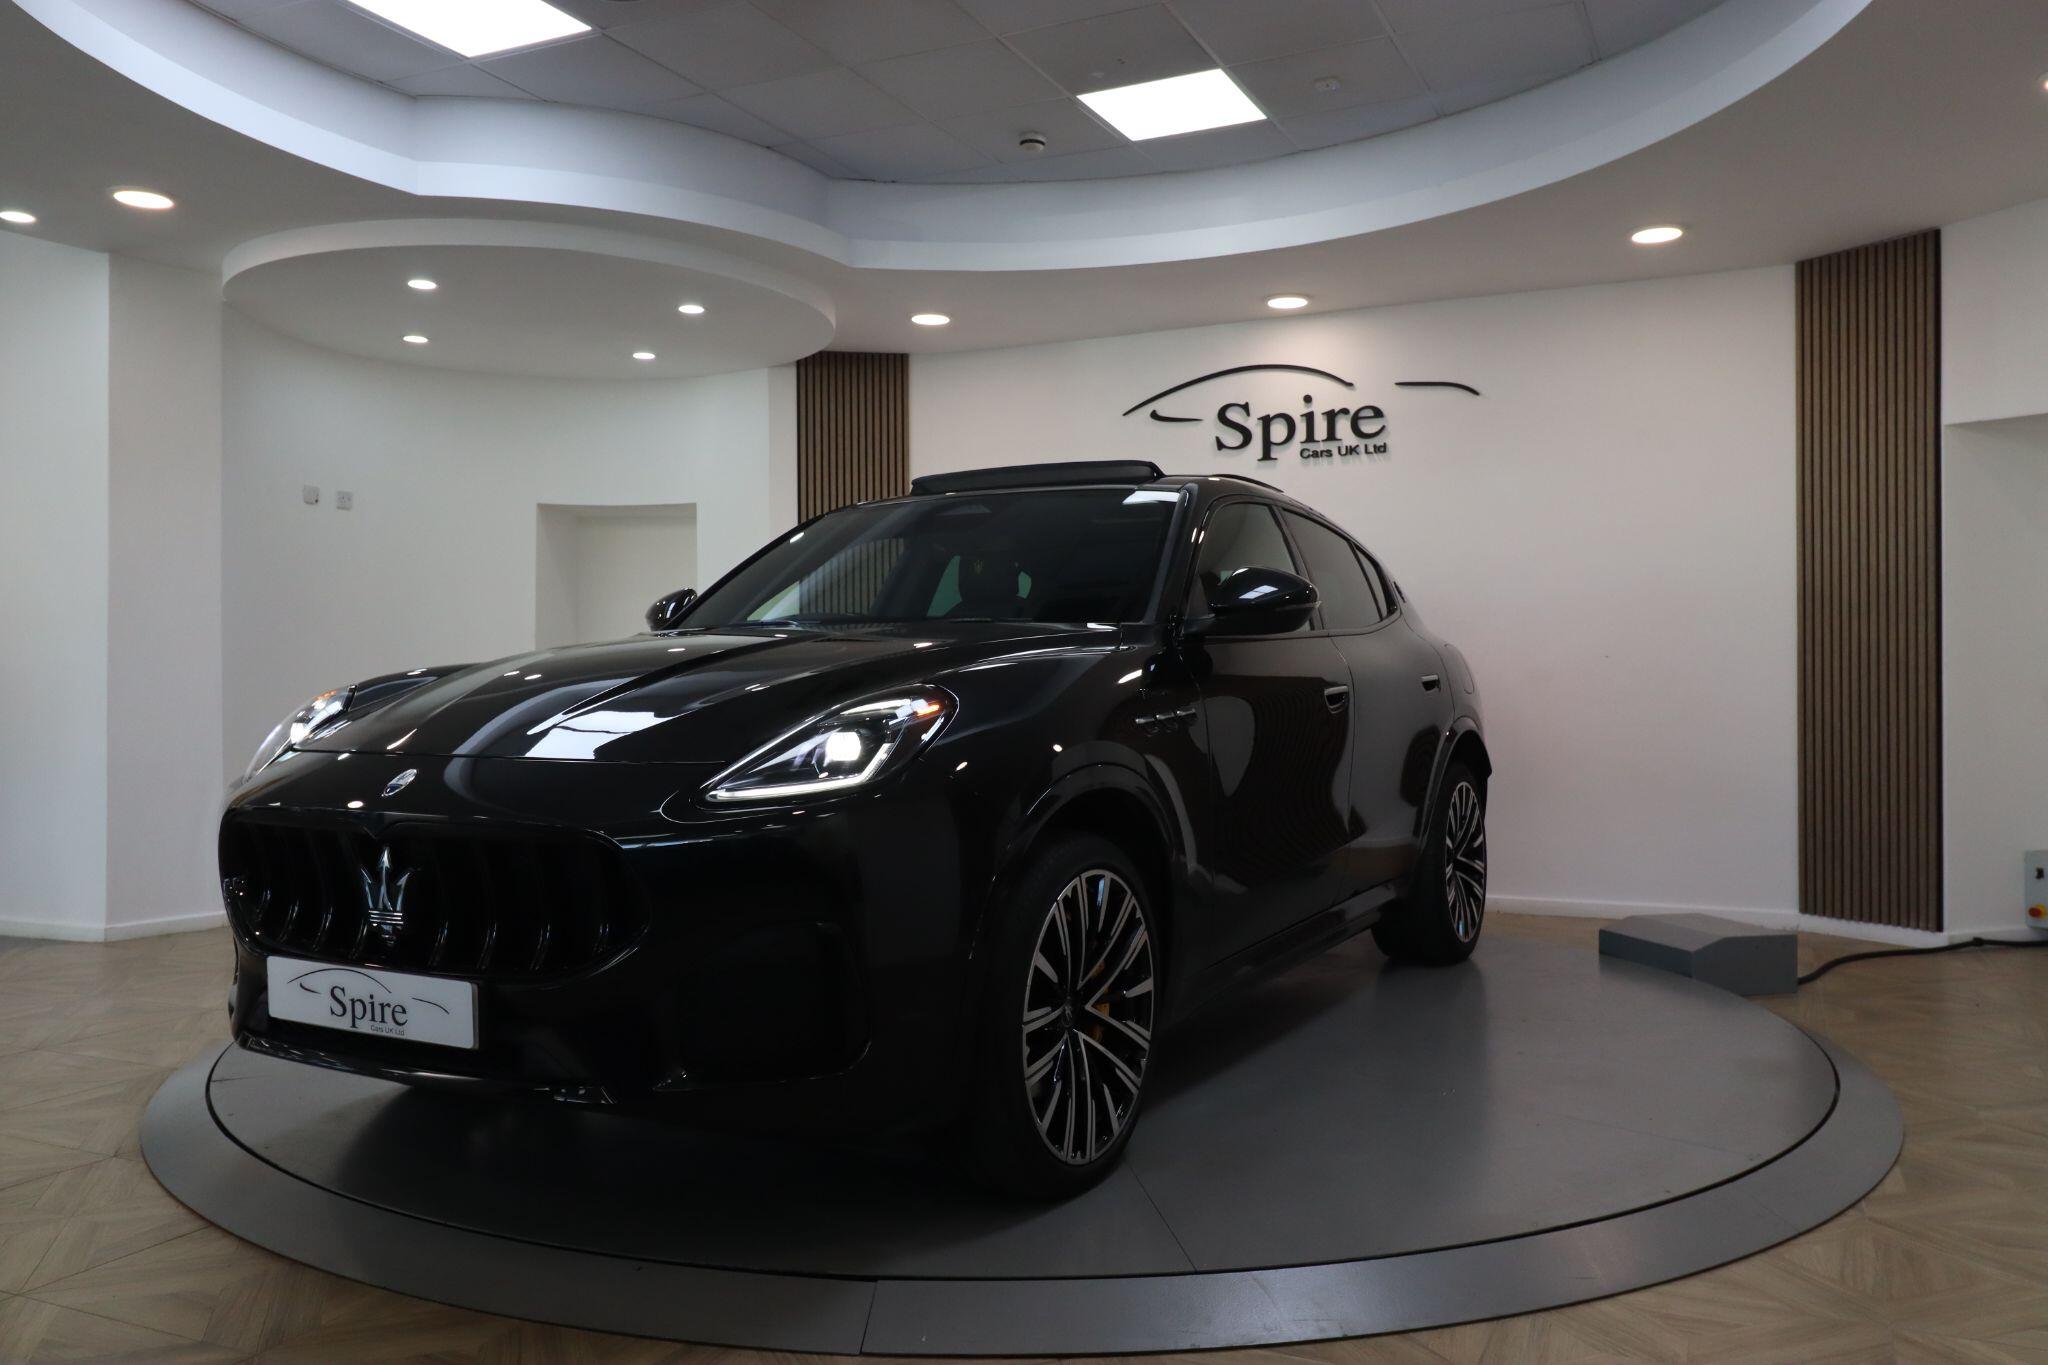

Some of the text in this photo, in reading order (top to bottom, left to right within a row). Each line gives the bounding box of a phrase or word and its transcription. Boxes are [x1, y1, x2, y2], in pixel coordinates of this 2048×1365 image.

[1215, 395, 1386, 461] Spire
[1300, 442, 1387, 459] Cars UK Ltd
[330, 985, 408, 1028] Spire
[370, 1024, 405, 1036] Cars UK Ltd
